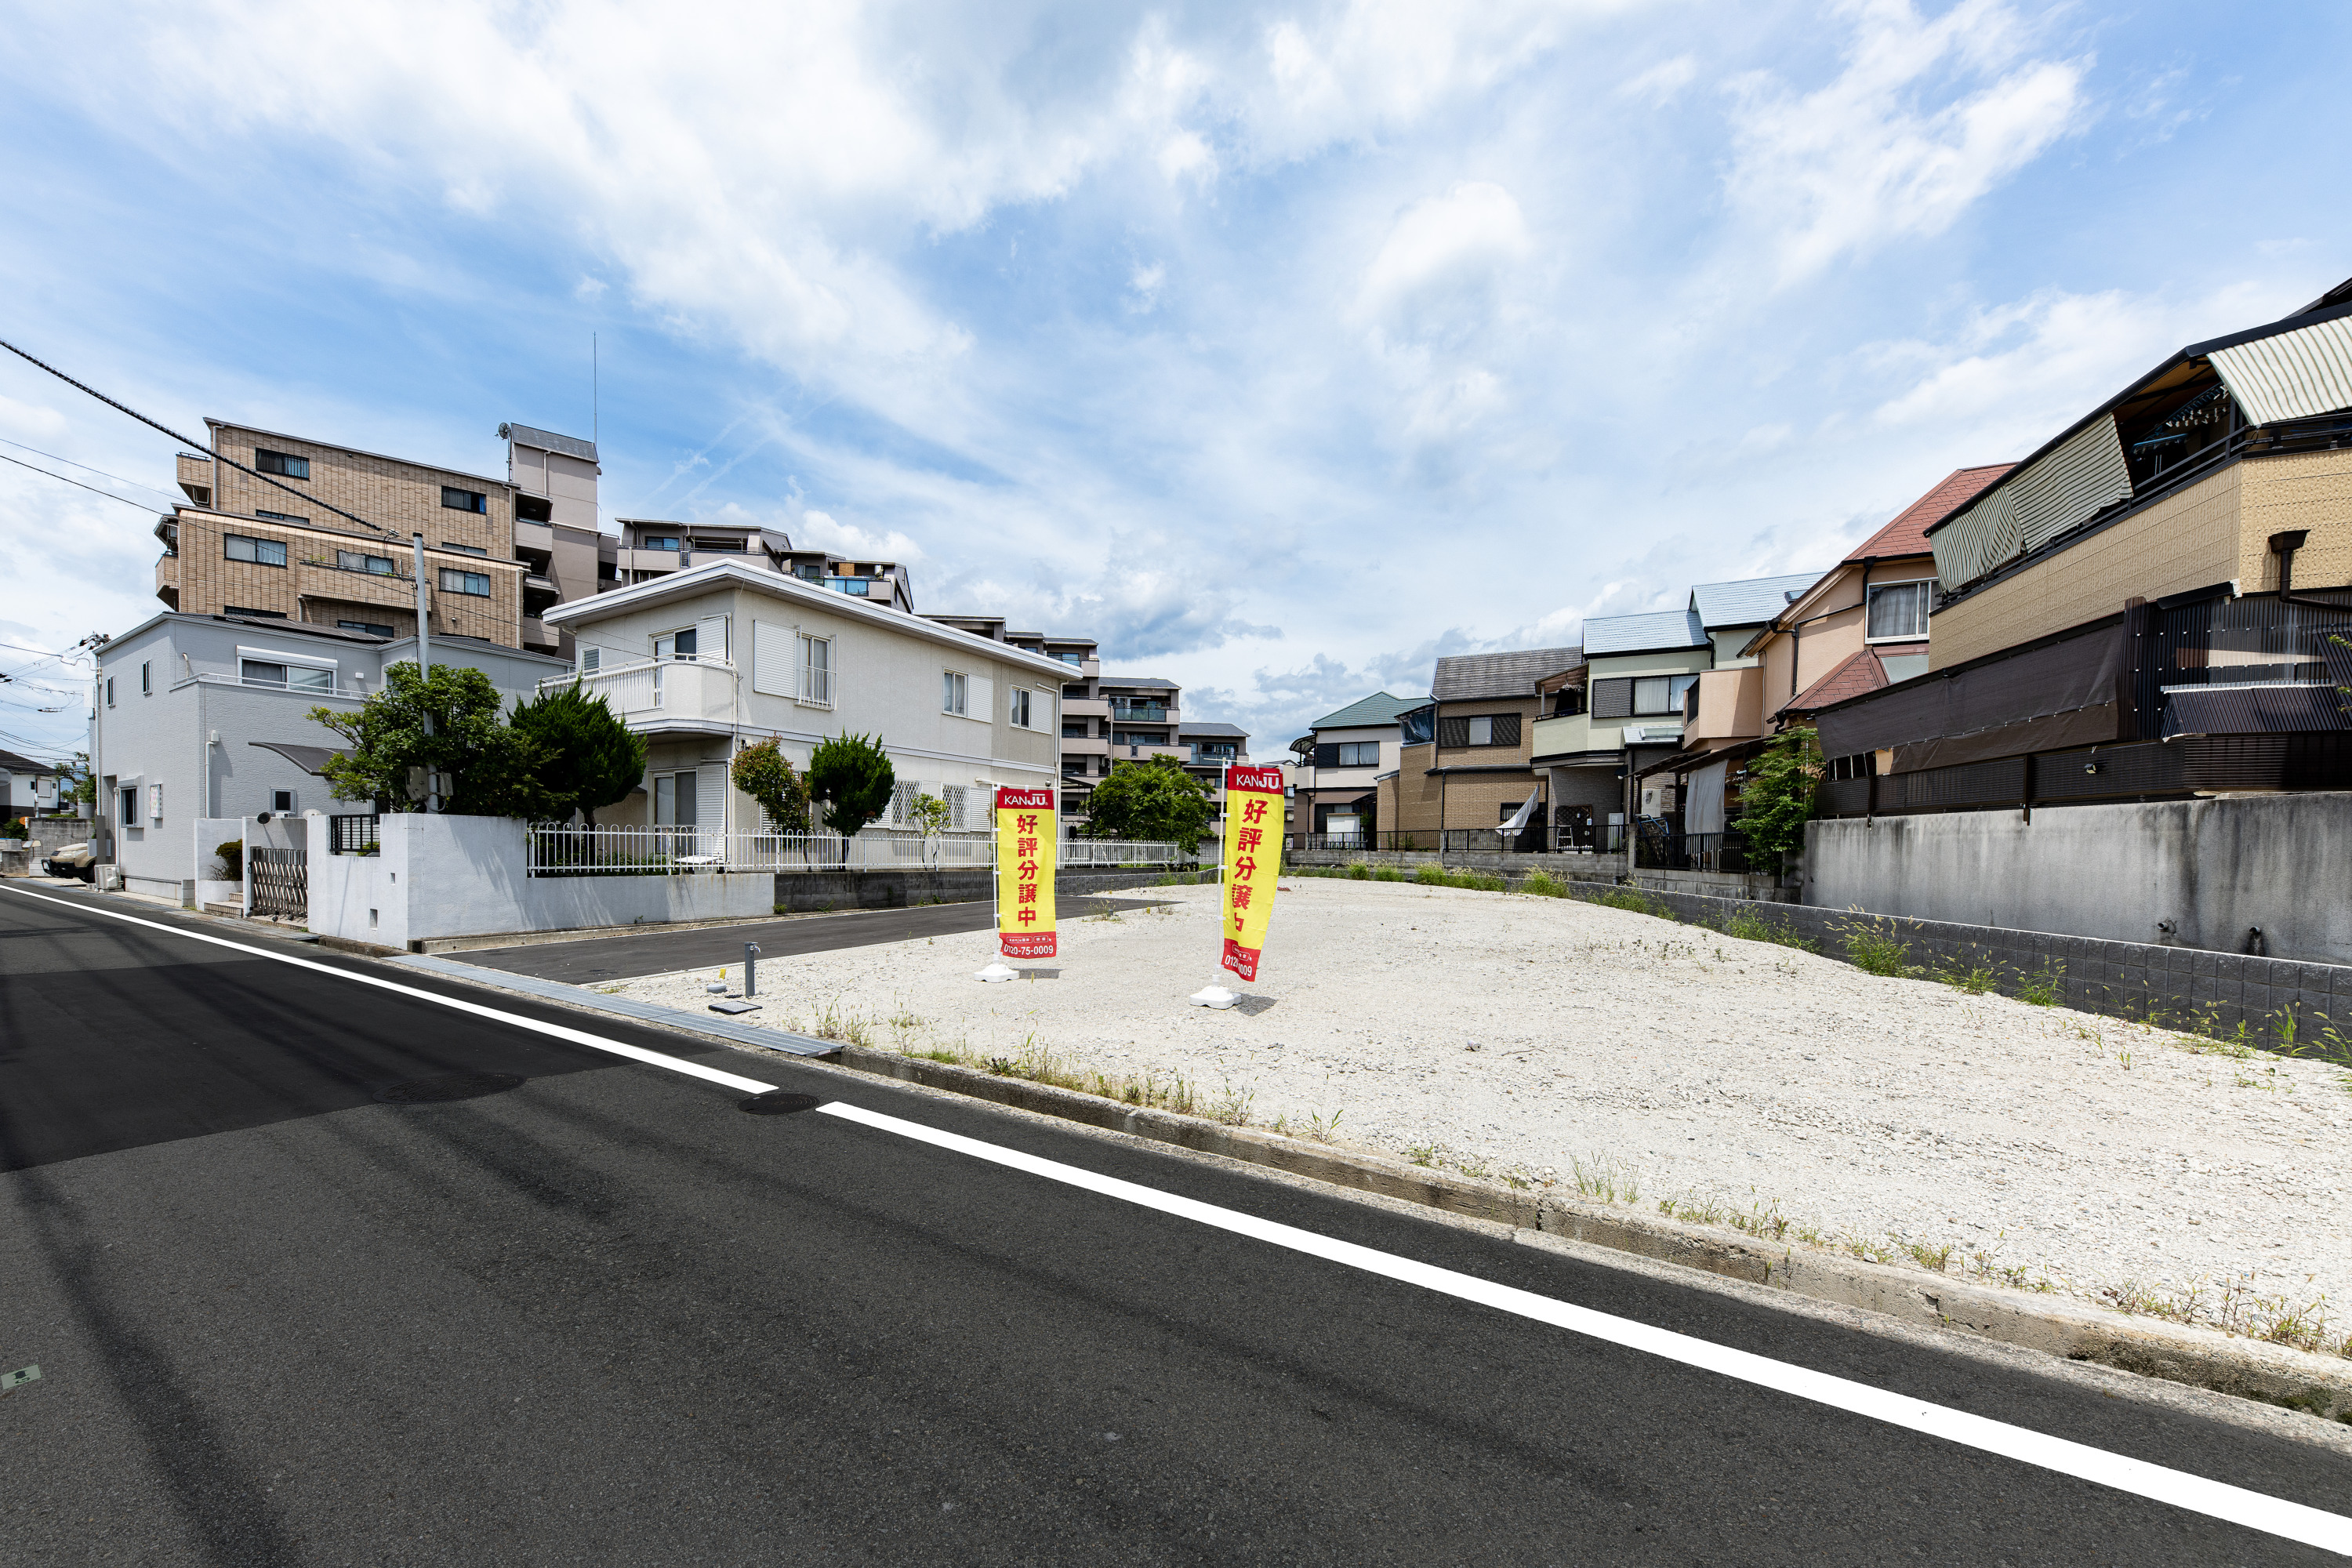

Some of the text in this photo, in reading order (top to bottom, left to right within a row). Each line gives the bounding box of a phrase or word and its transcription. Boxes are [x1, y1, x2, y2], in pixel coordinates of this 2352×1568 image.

[1016, 814, 1040, 927] 好評分譲中
[1004, 944, 1054, 956] 0120-75-0009
